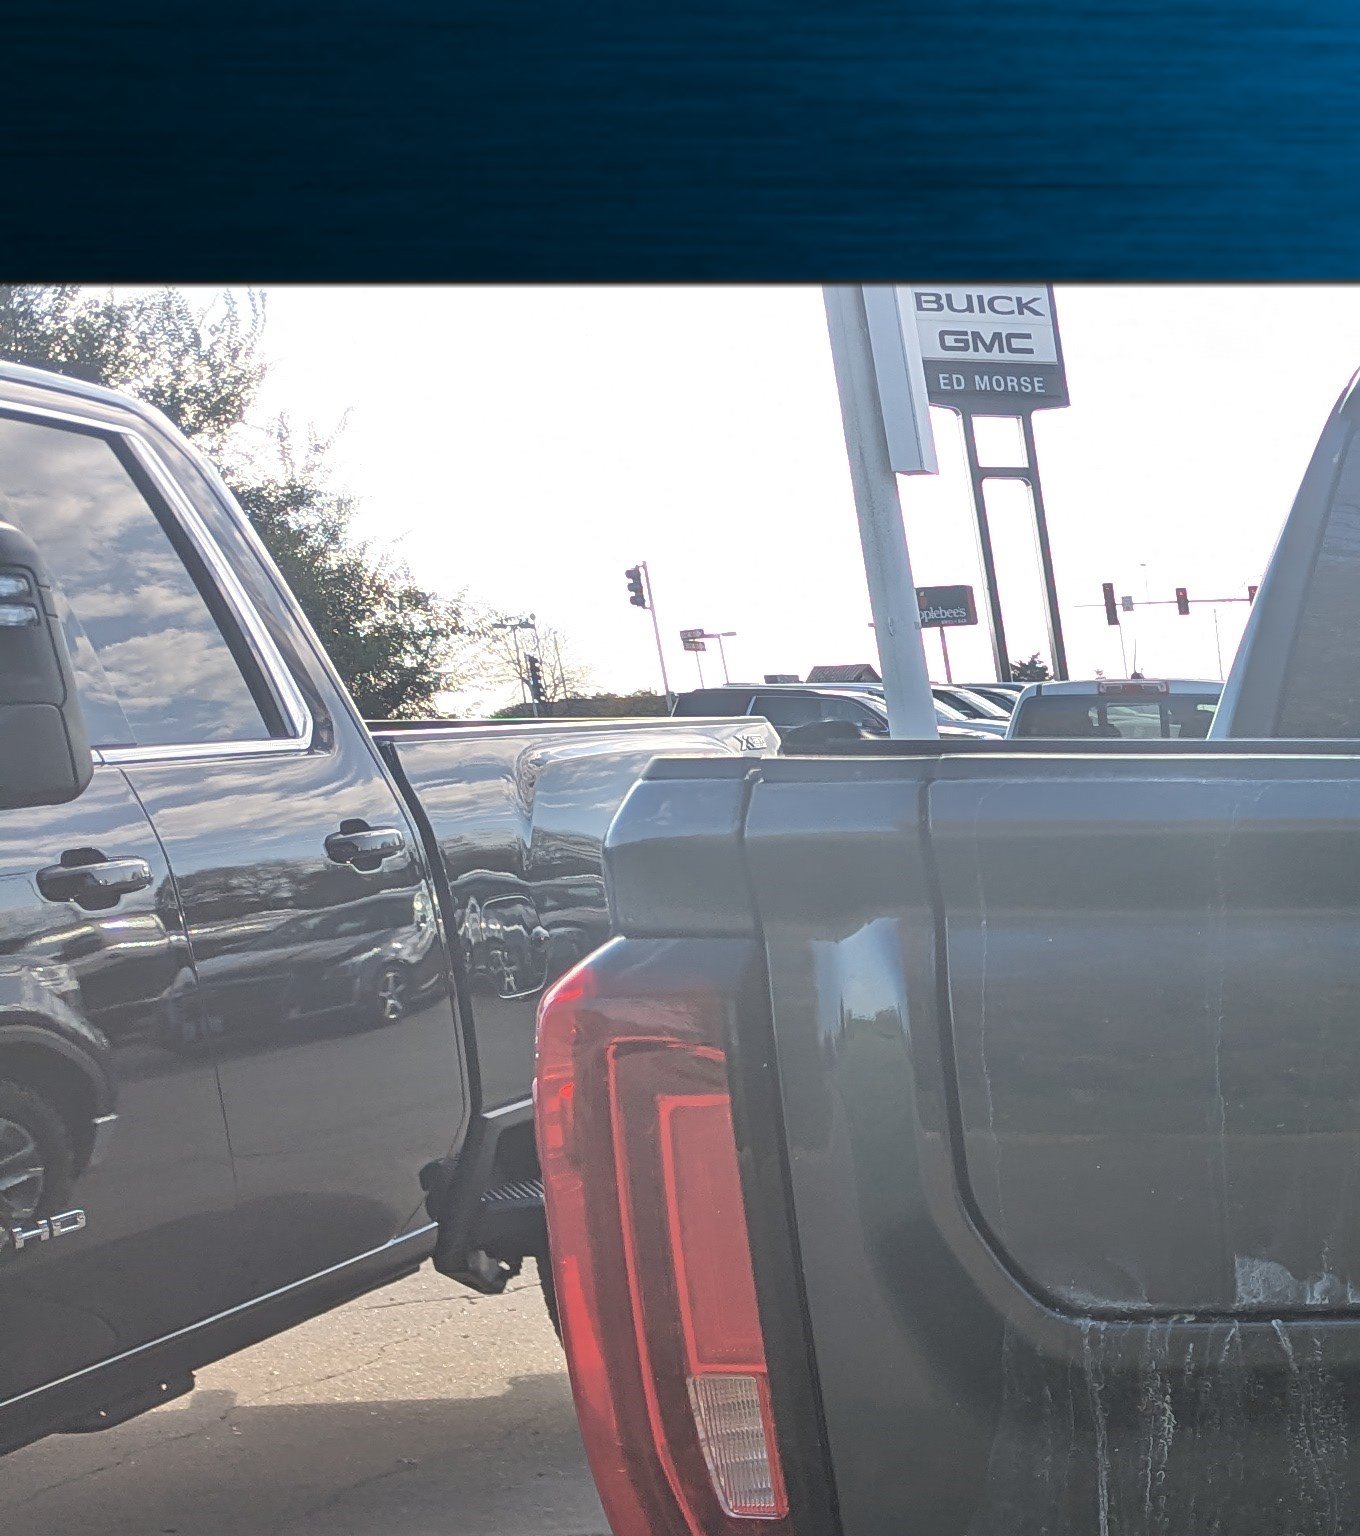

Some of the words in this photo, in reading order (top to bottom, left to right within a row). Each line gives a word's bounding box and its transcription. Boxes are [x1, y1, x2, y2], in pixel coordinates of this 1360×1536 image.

[914, 292, 1046, 316] BUICK
[938, 329, 1035, 355] GMC
[938, 373, 965, 391] ED
[975, 374, 1046, 393] MORSE
